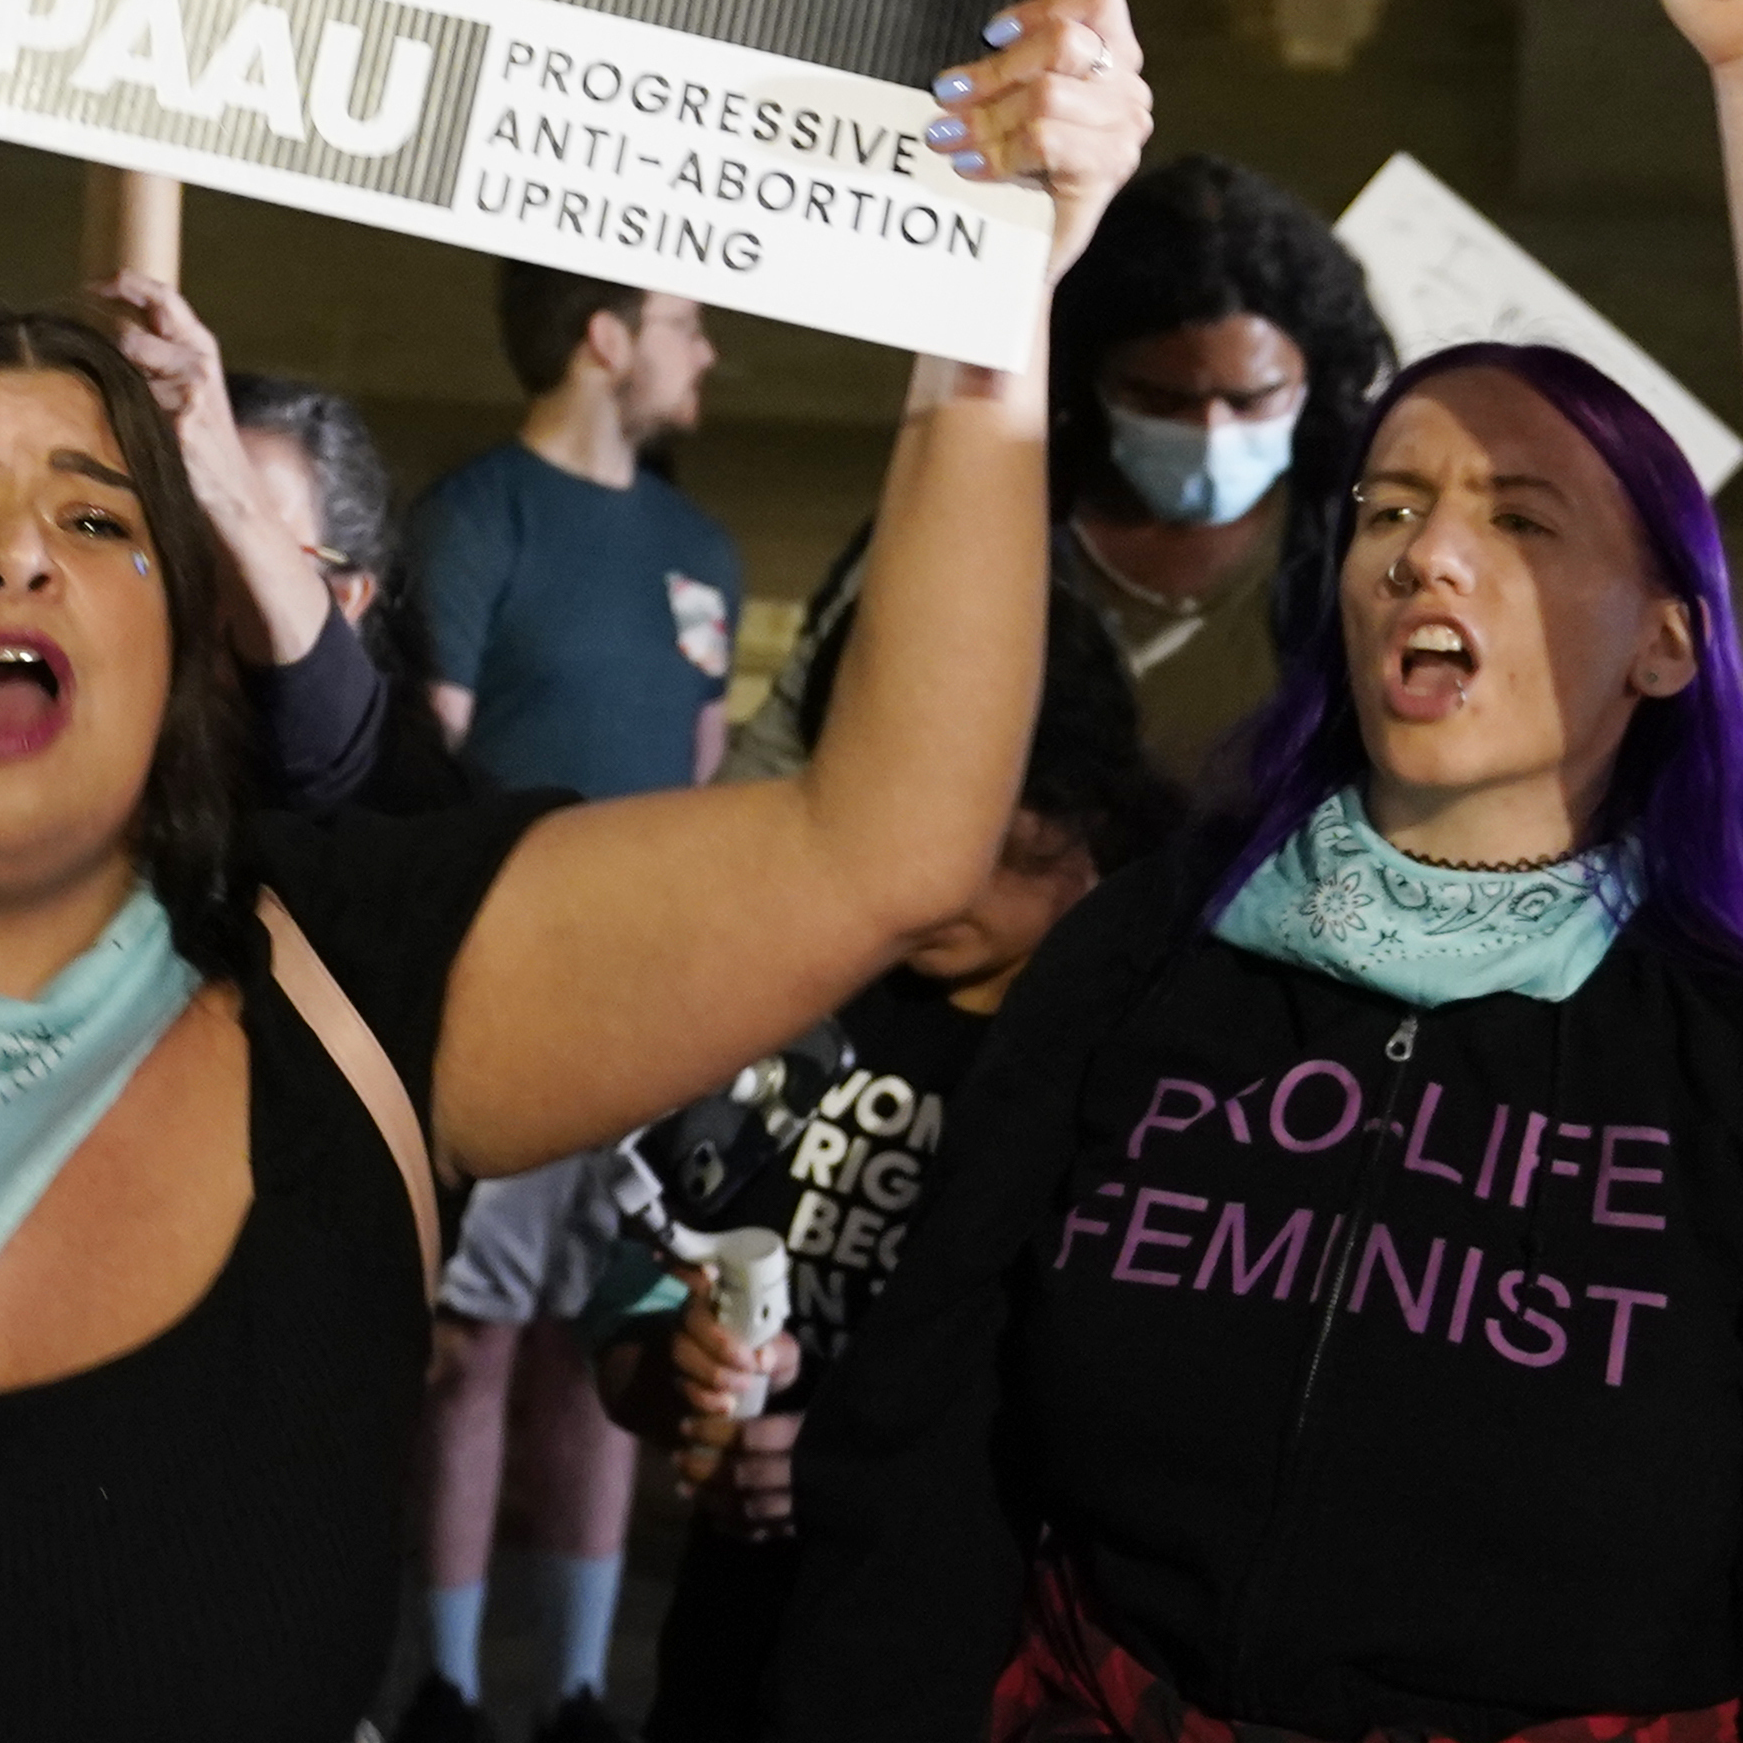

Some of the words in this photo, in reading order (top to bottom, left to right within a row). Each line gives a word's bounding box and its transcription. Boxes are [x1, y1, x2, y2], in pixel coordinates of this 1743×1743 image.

[502, 40, 917, 179] PROGRESSIVE
[476, 170, 763, 272] UPRISING
[488, 106, 987, 260] ANTI-ABORTION
[789, 1119, 921, 1212] RIG
[1053, 1182, 1669, 1387] FEMINIST
